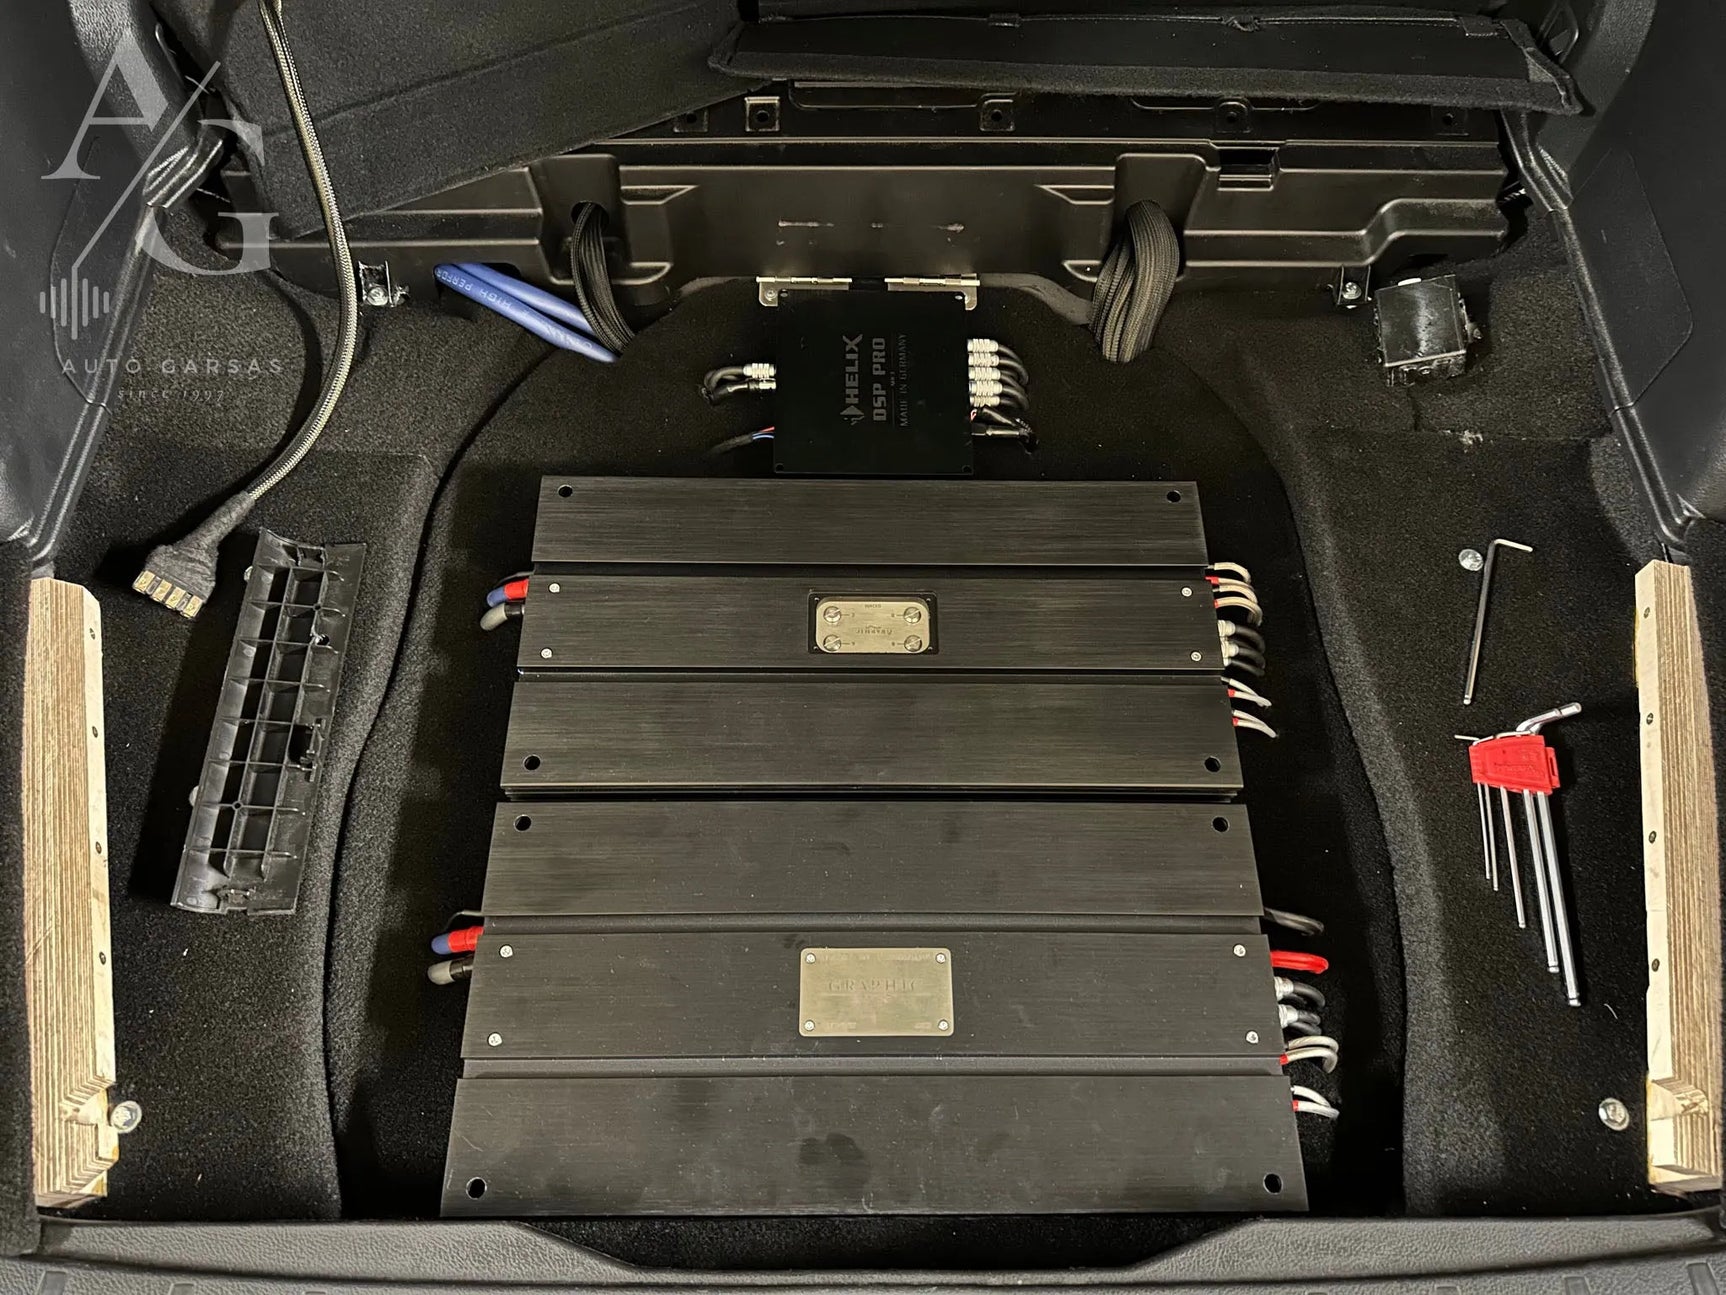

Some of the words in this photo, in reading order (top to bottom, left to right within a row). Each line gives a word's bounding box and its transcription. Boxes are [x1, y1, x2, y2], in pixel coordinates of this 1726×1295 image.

[478, 287, 513, 310] HIGH
[842, 333, 863, 405] HELIX
[872, 337, 886, 376] PRO
[898, 332, 908, 381] GERMANY
[872, 383, 887, 422] DSP
[899, 383, 908, 397] IN
[899, 399, 908, 427] MADE
